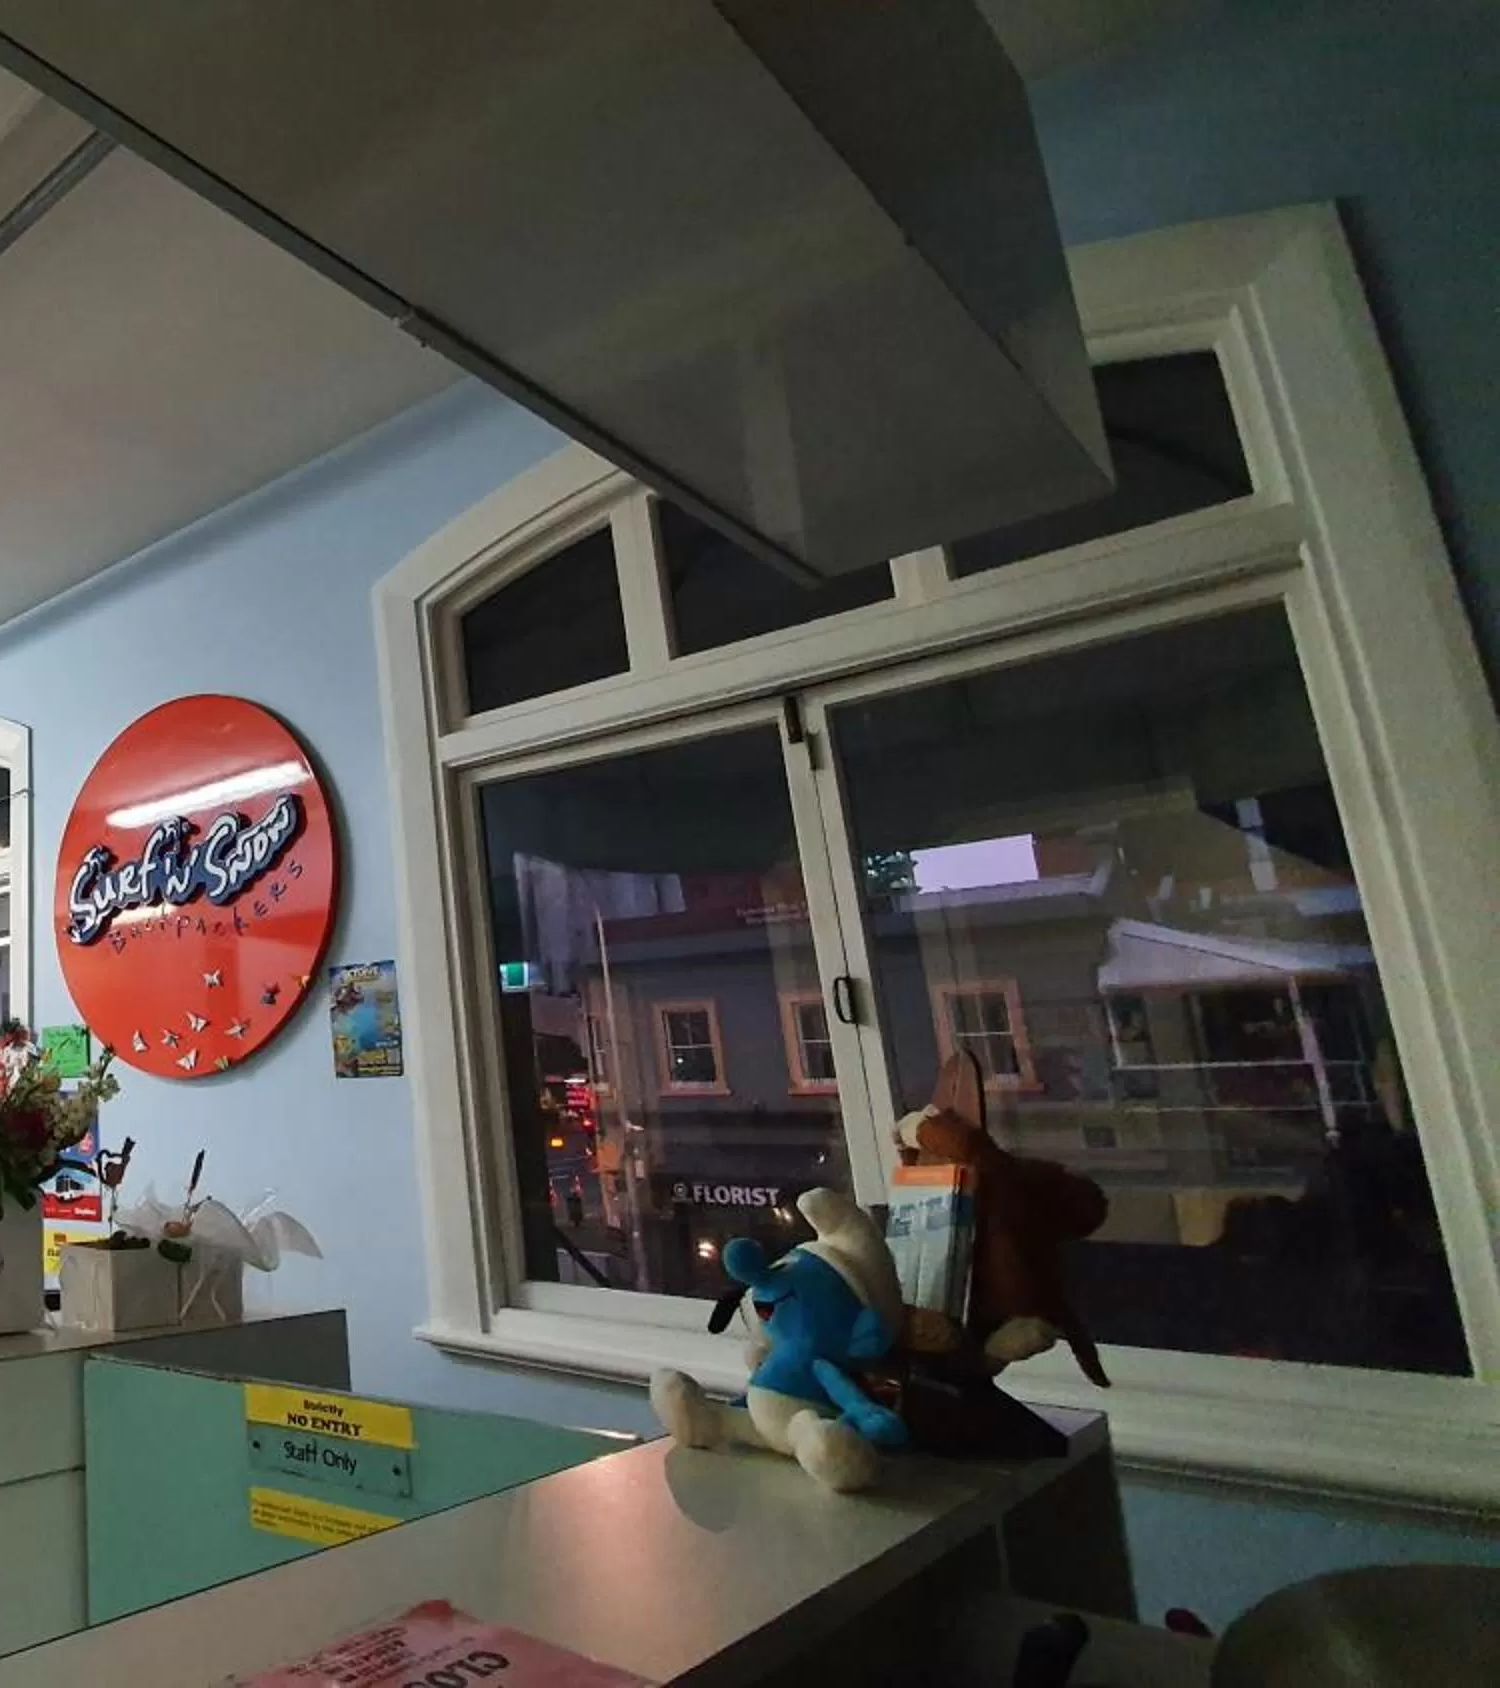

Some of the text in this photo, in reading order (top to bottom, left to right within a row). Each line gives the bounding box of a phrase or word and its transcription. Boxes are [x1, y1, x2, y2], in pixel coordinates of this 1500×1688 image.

[204, 796, 292, 900] Snow
[693, 1185, 780, 1206] FLORIST
[286, 1412, 363, 1437] NO ENTRY
[283, 1439, 357, 1476] Staff Only
